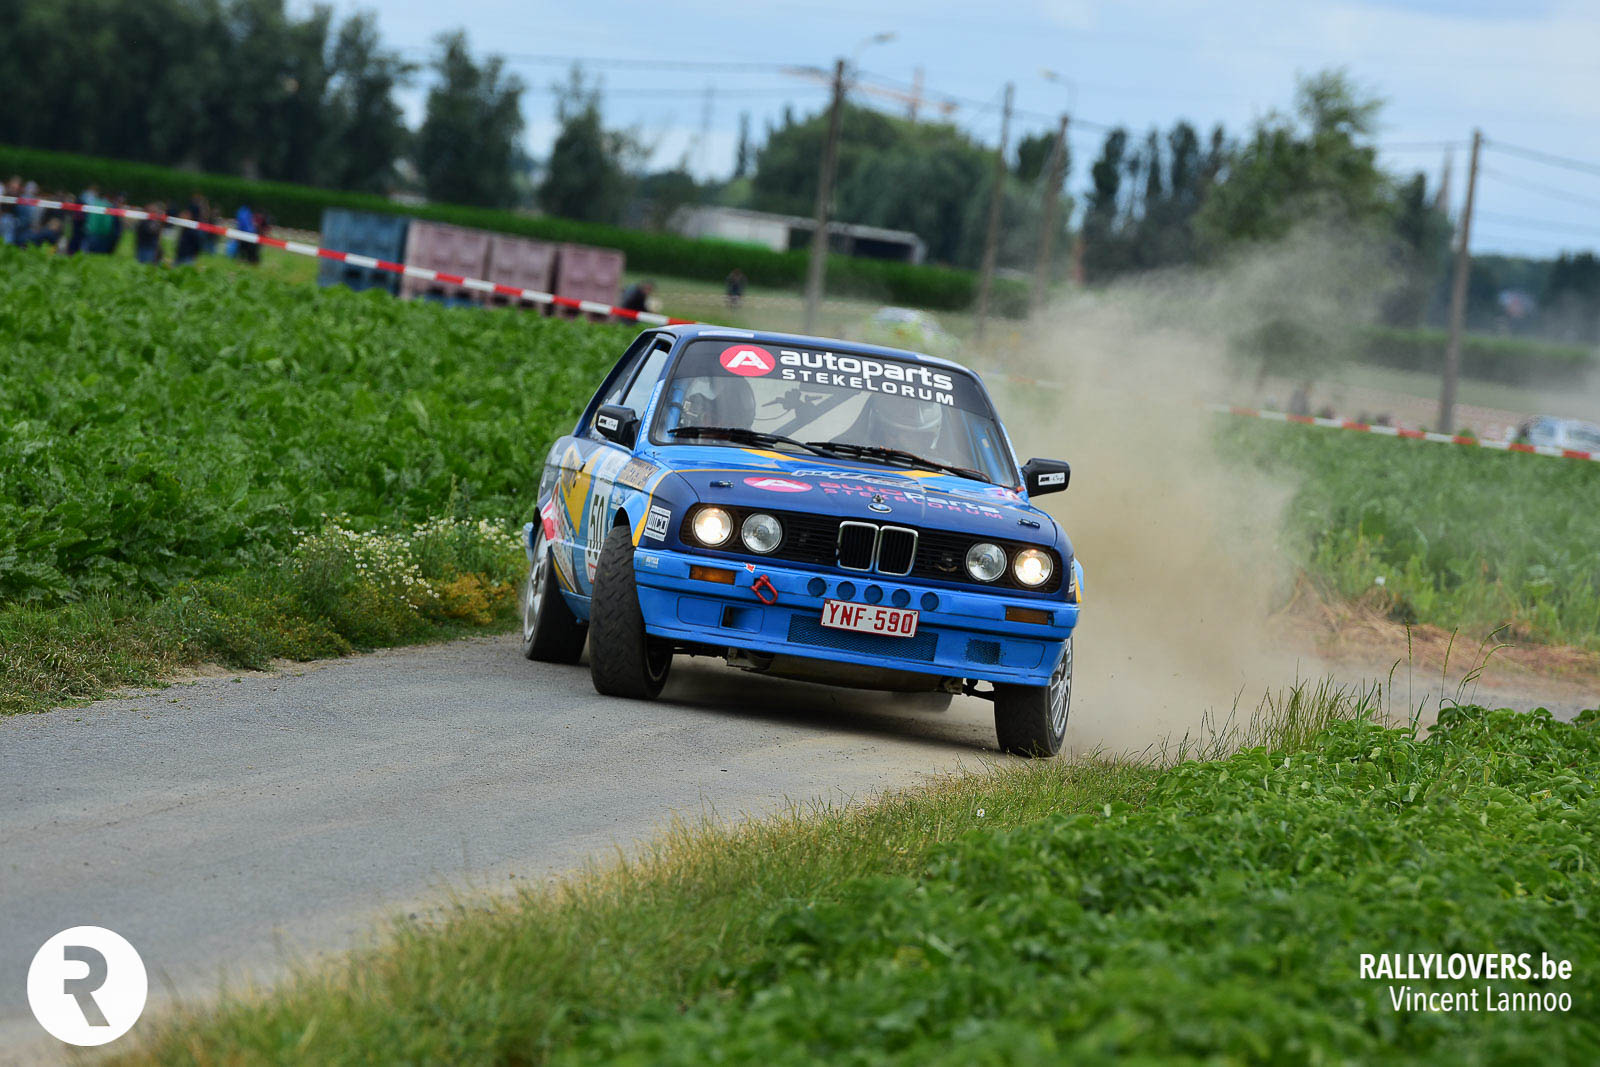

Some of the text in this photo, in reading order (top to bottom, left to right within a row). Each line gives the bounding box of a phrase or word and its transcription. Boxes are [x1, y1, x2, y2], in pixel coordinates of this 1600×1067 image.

[780, 350, 953, 391] autoparts
[782, 368, 955, 406] STEKELORUM
[829, 604, 914, 633] YNF-590
